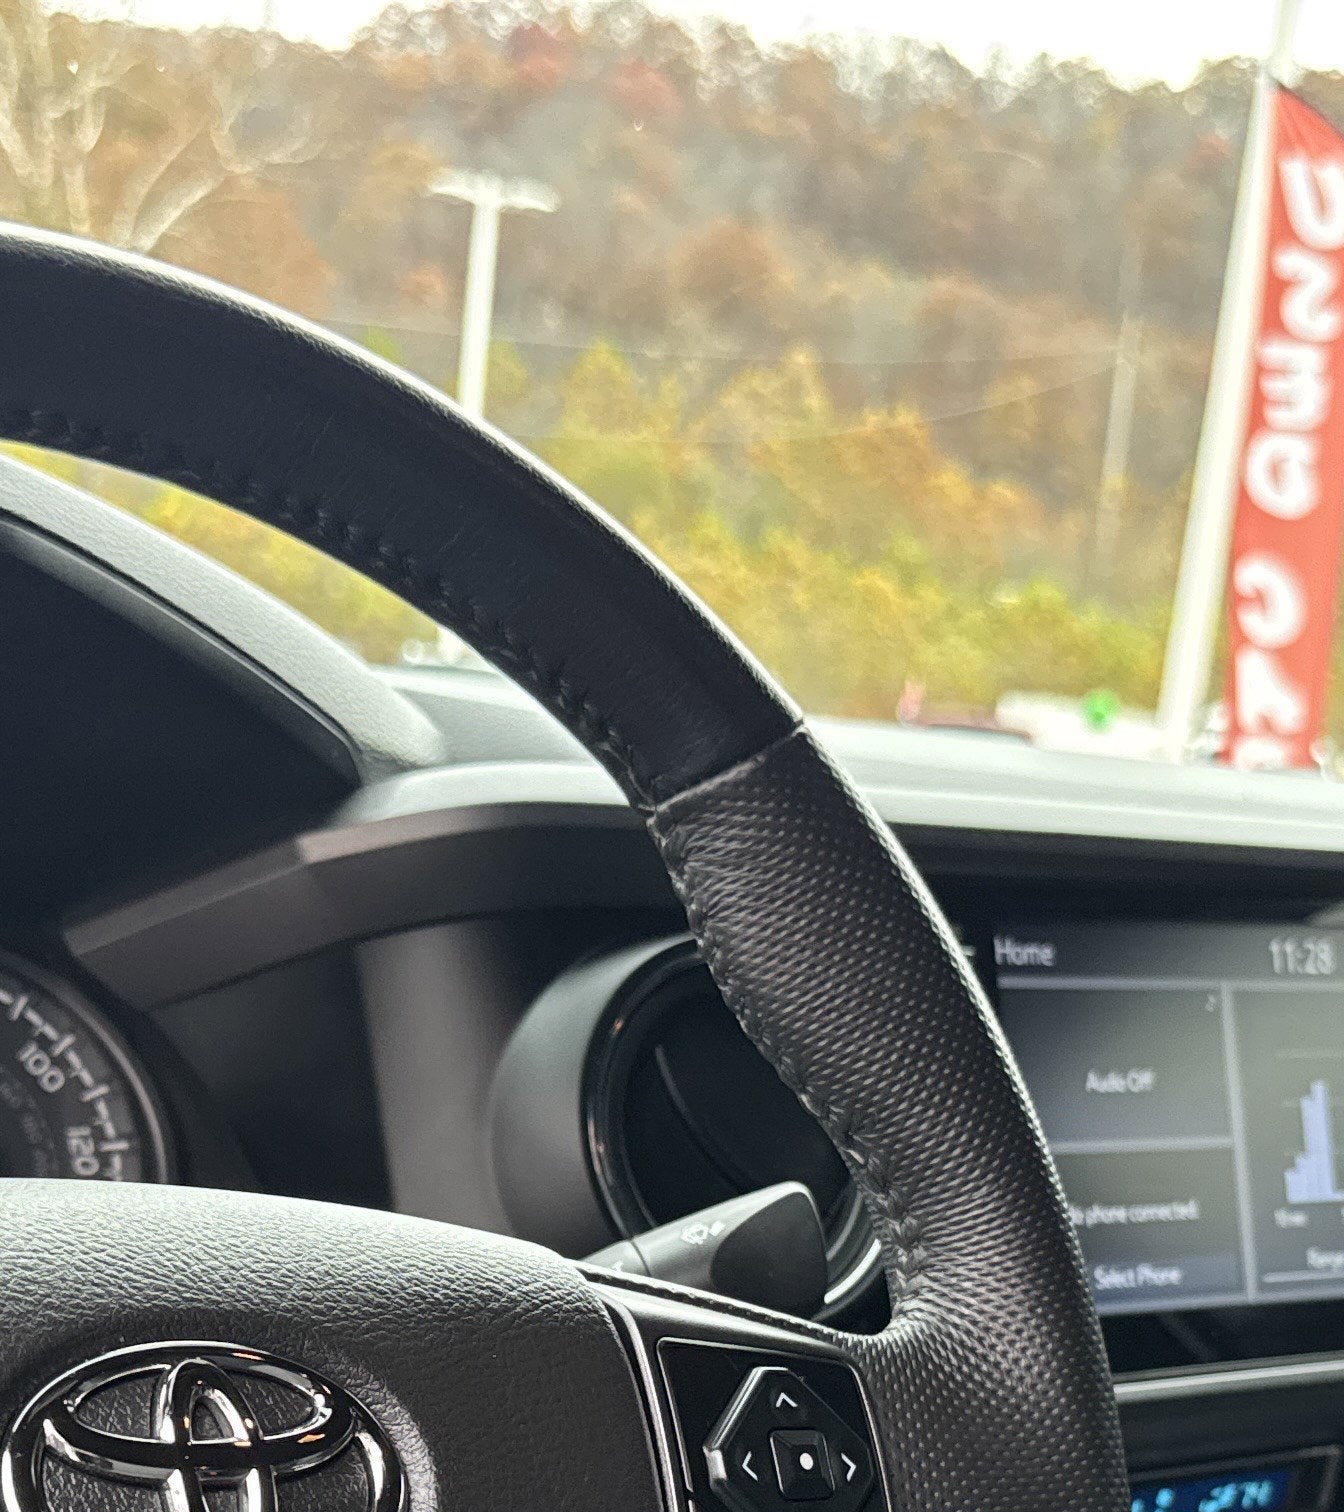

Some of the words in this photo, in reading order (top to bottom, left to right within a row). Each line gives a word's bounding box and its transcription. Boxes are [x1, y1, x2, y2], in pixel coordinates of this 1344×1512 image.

[994, 937, 1054, 967] Home
[1268, 938, 1337, 975] 11:28
[17, 1042, 66, 1094] 100
[65, 1125, 100, 1177] 120
